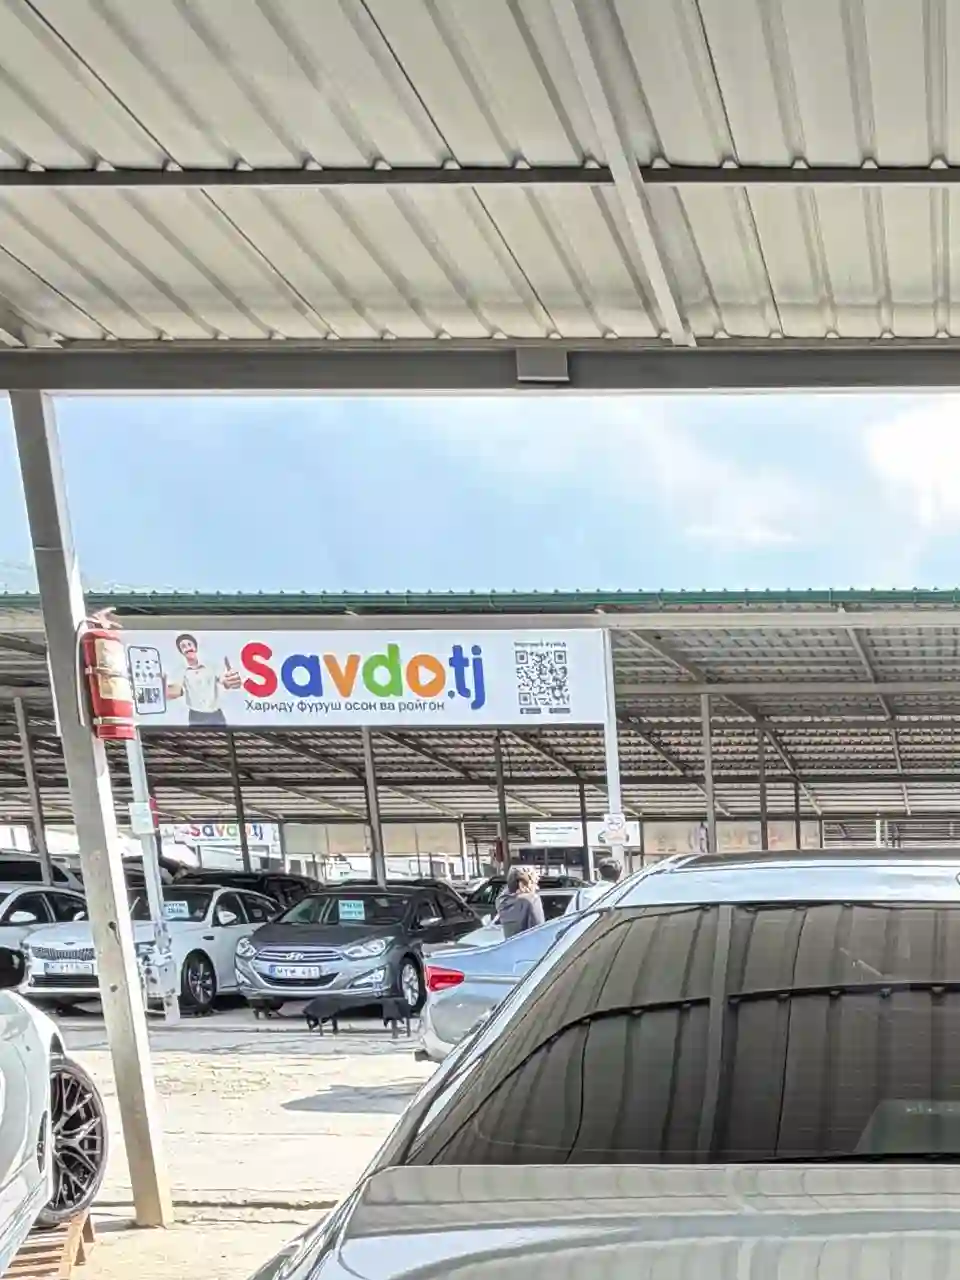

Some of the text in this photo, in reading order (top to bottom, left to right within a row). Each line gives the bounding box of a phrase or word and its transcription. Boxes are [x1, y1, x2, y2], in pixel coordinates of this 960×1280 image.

[240, 642, 486, 710] Savdo.tj
[345, 702, 377, 711] осон
[380, 702, 395, 711] ва
[398, 699, 445, 712] ройгон
